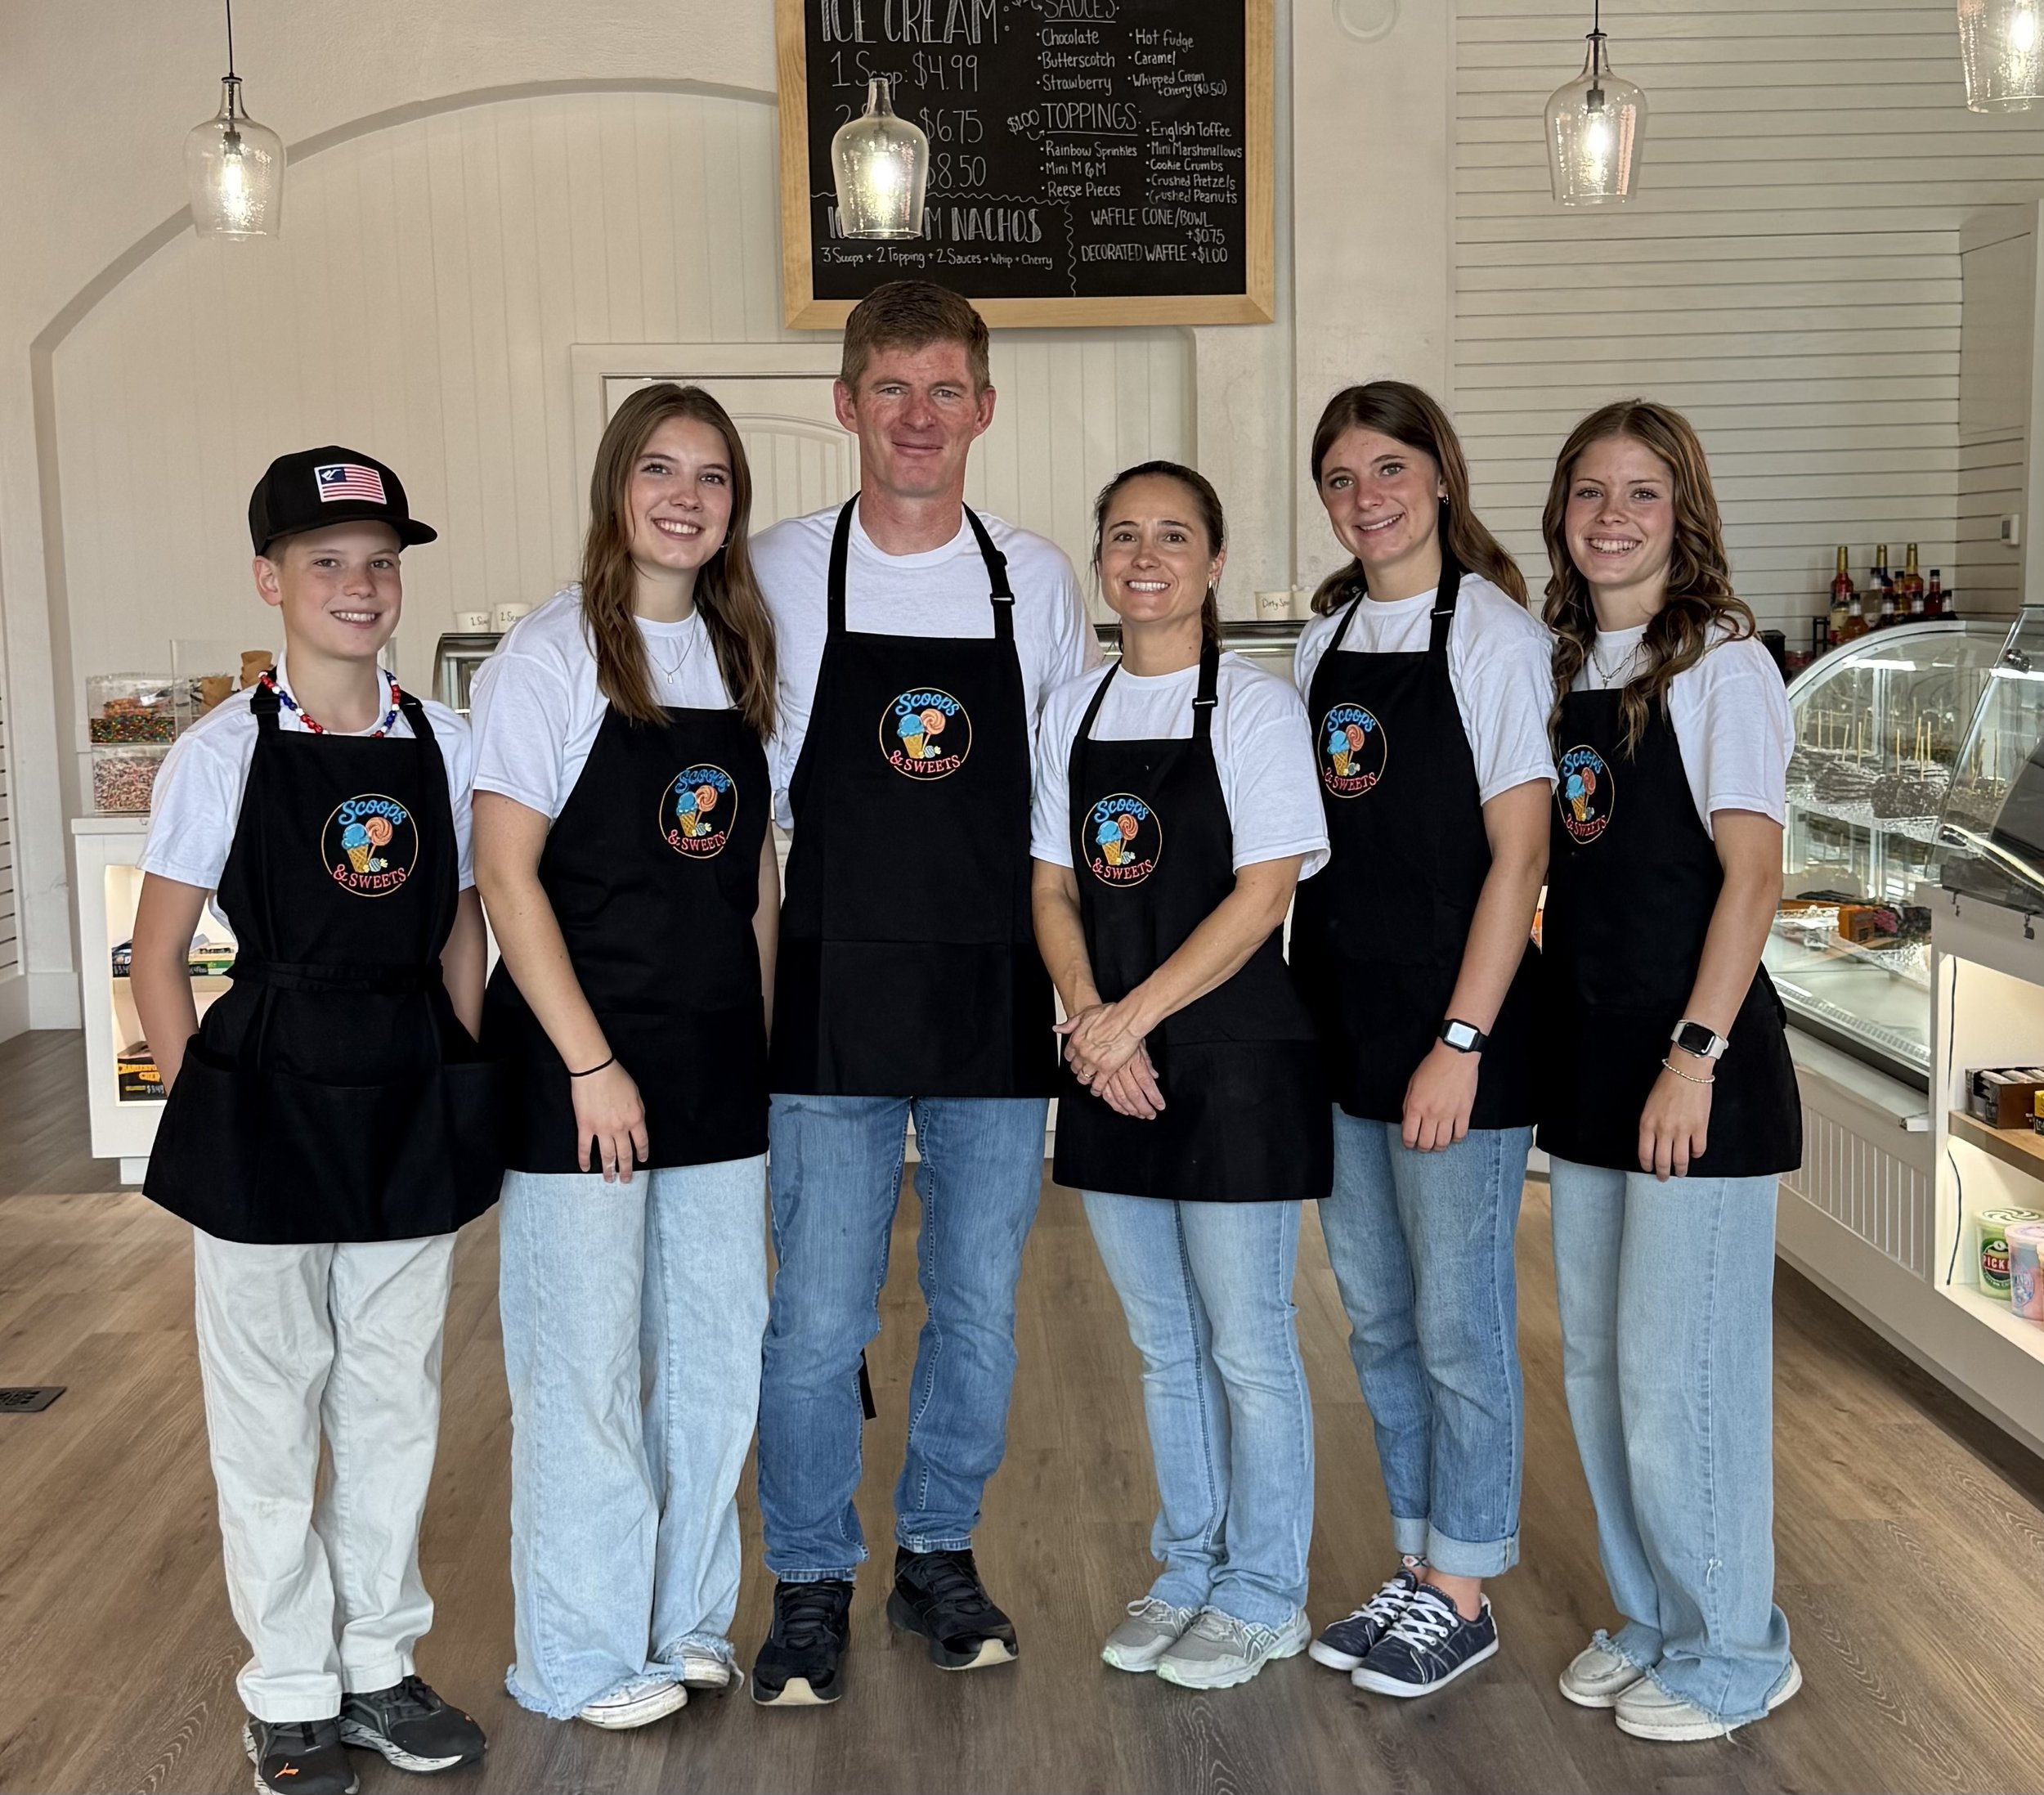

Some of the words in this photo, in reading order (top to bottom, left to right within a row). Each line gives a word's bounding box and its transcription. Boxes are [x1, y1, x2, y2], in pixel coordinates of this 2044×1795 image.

[821, 0, 877, 43] ICE
[1041, 28, 1100, 47] Chocolate
[1135, 28, 1160, 46] Hot
[1042, 51, 1116, 70] Butterscotch
[1134, 50, 1177, 66] Caramel
[830, 50, 851, 88] 1
[912, 50, 978, 92] $4.99
[1132, 70, 1175, 90] Whipped
[1177, 70, 1205, 83] Cream
[1042, 74, 1113, 96] Strawberry
[920, 106, 984, 145] $6.75
[1150, 121, 1195, 142] English
[1196, 122, 1232, 137] Toffee
[1045, 140, 1091, 157] Rainbow
[1094, 141, 1138, 160] Sprinkles
[1150, 141, 1171, 155] Mini
[1172, 141, 1243, 159] Marshmallows
[1046, 162, 1069, 176] Mini
[1150, 158, 1181, 171] Cookie
[1184, 158, 1224, 173] Crumbs
[1047, 181, 1083, 198] Reese
[1086, 182, 1121, 198] Pieces
[1151, 173, 1191, 187] Crushed
[1193, 173, 1236, 191] Pretzels
[1149, 189, 1191, 204] Crushed
[1194, 189, 1238, 204] Peanuts
[951, 207, 1042, 244] NACHOS
[1090, 207, 1139, 227] WAFFLE
[1141, 207, 1214, 229] CONE/BOWL
[821, 247, 831, 263] 3
[832, 249, 864, 267] Scoops
[876, 246, 887, 263] 2
[888, 247, 926, 268] Topping
[936, 249, 948, 264] 2
[948, 249, 982, 265] Sauces
[990, 254, 1013, 268] Whip
[1022, 254, 1053, 271] Cherry
[1080, 243, 1143, 263] DECORATED
[1144, 245, 1188, 262] WAFFLE
[894, 693, 960, 716] Scoops
[1327, 708, 1376, 733] Scoops
[675, 769, 732, 794] Scoops
[338, 799, 407, 825] Scoops
[1093, 798, 1150, 823] Scoops
[1983, 1254, 2010, 1271] PICK
